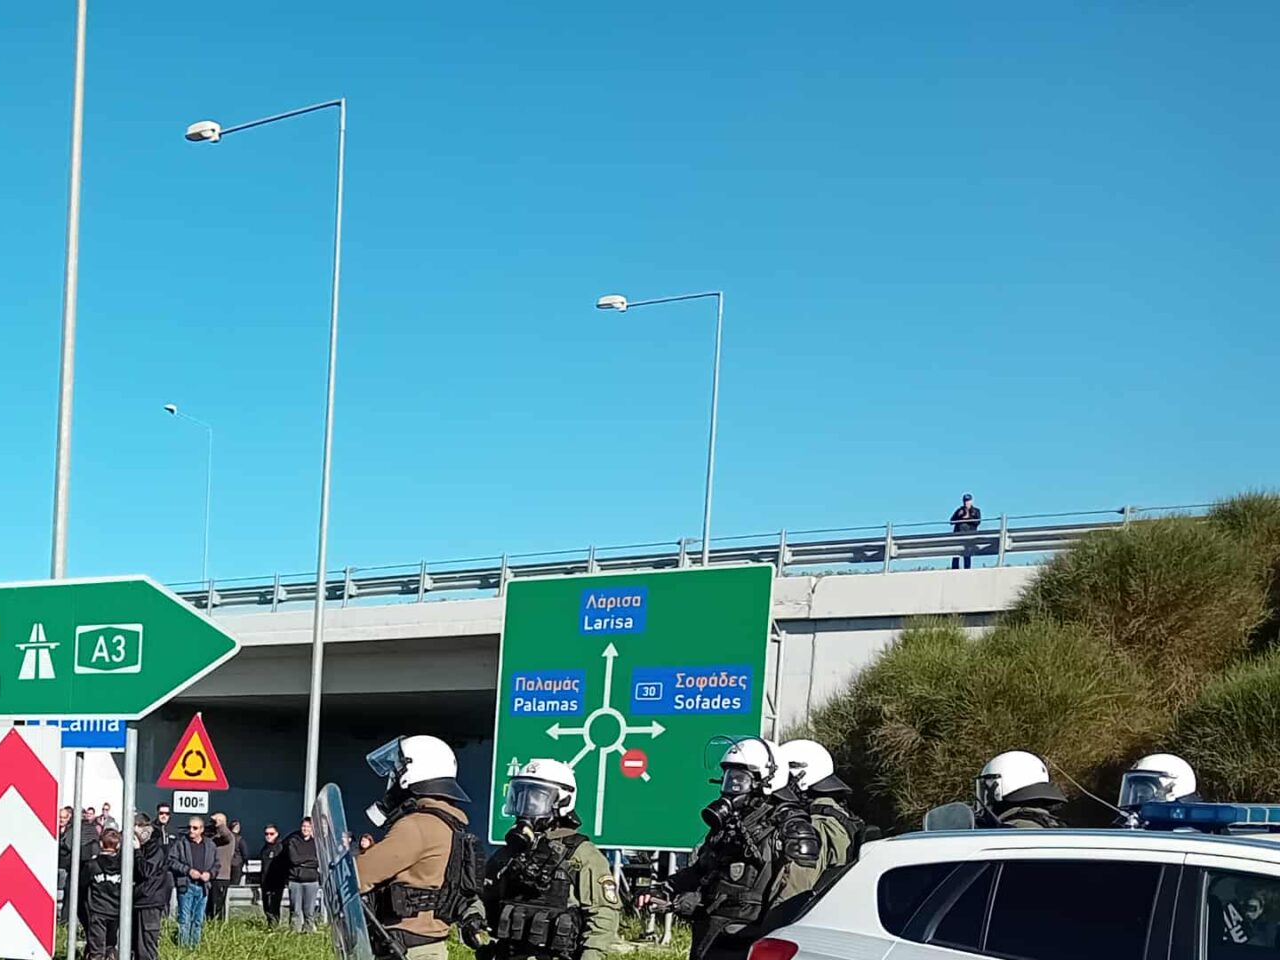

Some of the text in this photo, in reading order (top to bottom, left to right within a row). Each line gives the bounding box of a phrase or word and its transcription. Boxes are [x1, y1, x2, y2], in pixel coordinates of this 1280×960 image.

[586, 594, 641, 611] Λάρισα
[583, 615, 633, 631] Larisa
[91, 635, 126, 663] A3
[515, 676, 580, 693] Παλαμάς
[674, 672, 748, 691] Σοφάδες
[642, 686, 656, 697] 30
[514, 696, 578, 712] Palamas
[674, 694, 741, 710] Sofades
[179, 796, 198, 808] 100
